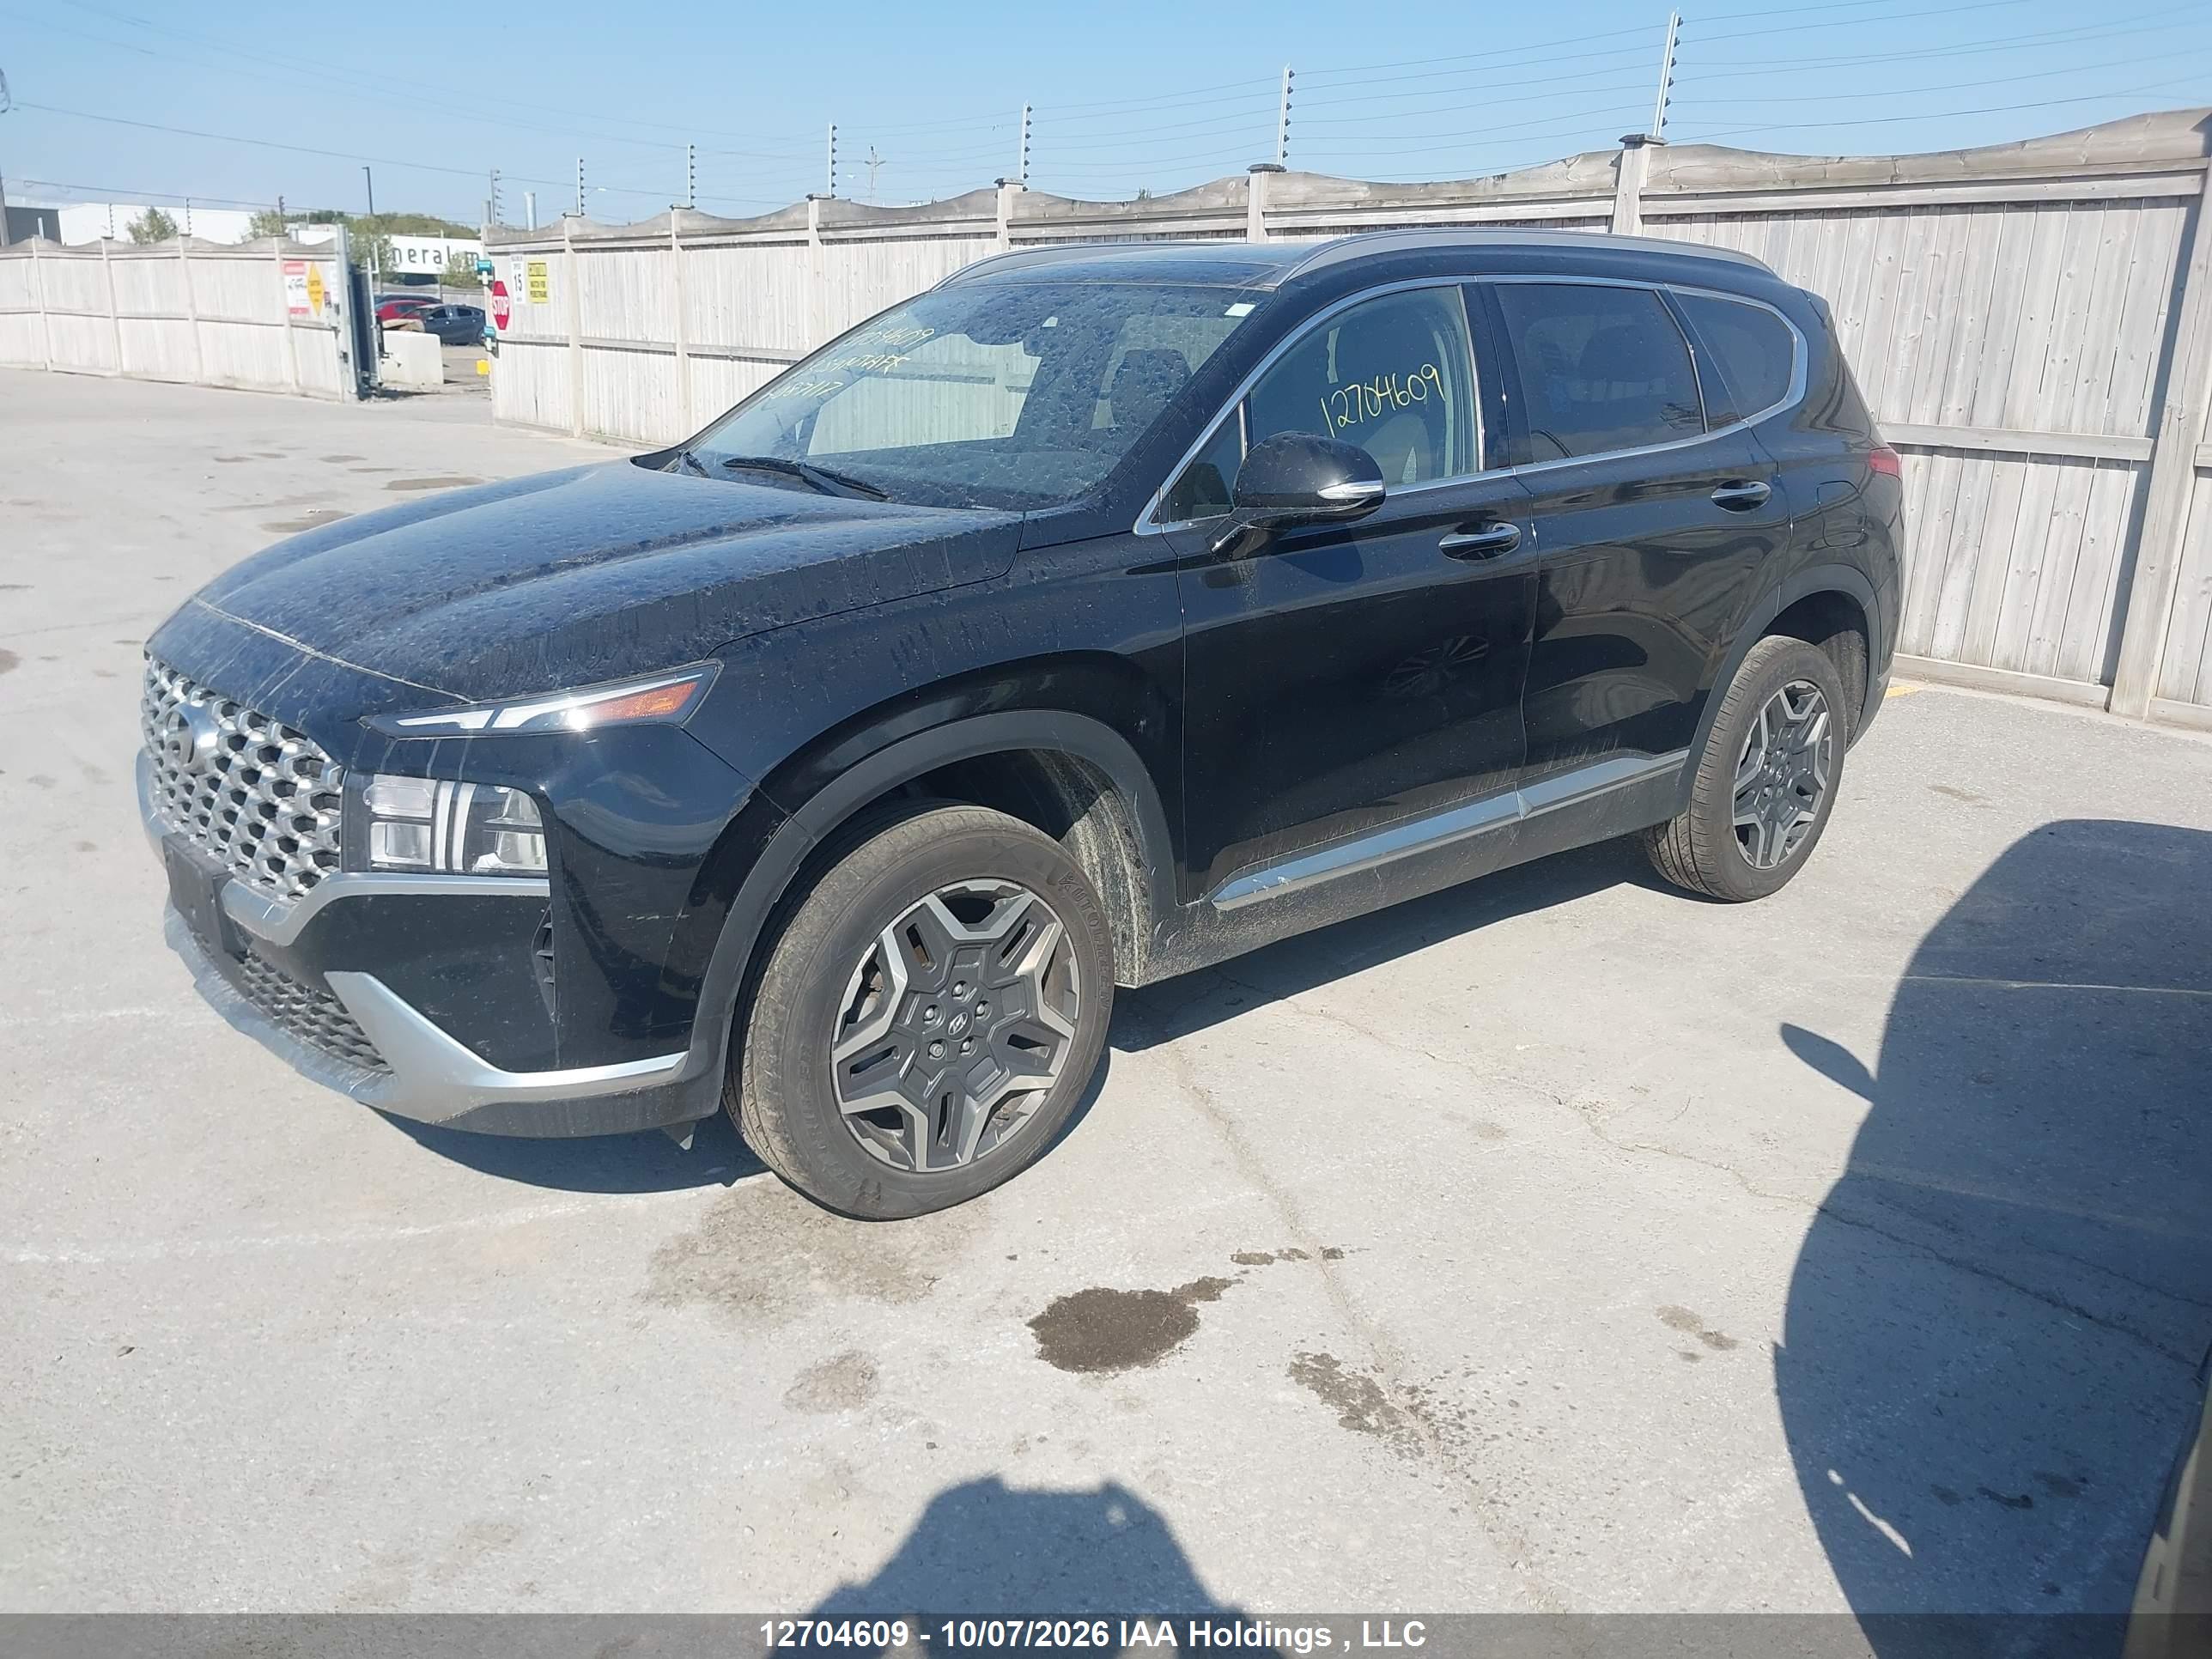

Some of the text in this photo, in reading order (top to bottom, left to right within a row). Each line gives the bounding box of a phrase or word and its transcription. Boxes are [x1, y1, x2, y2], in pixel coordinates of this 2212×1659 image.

[514, 274, 523, 292] 15
[493, 297, 509, 316] STOP
[1320, 364, 1446, 439] 12704609
